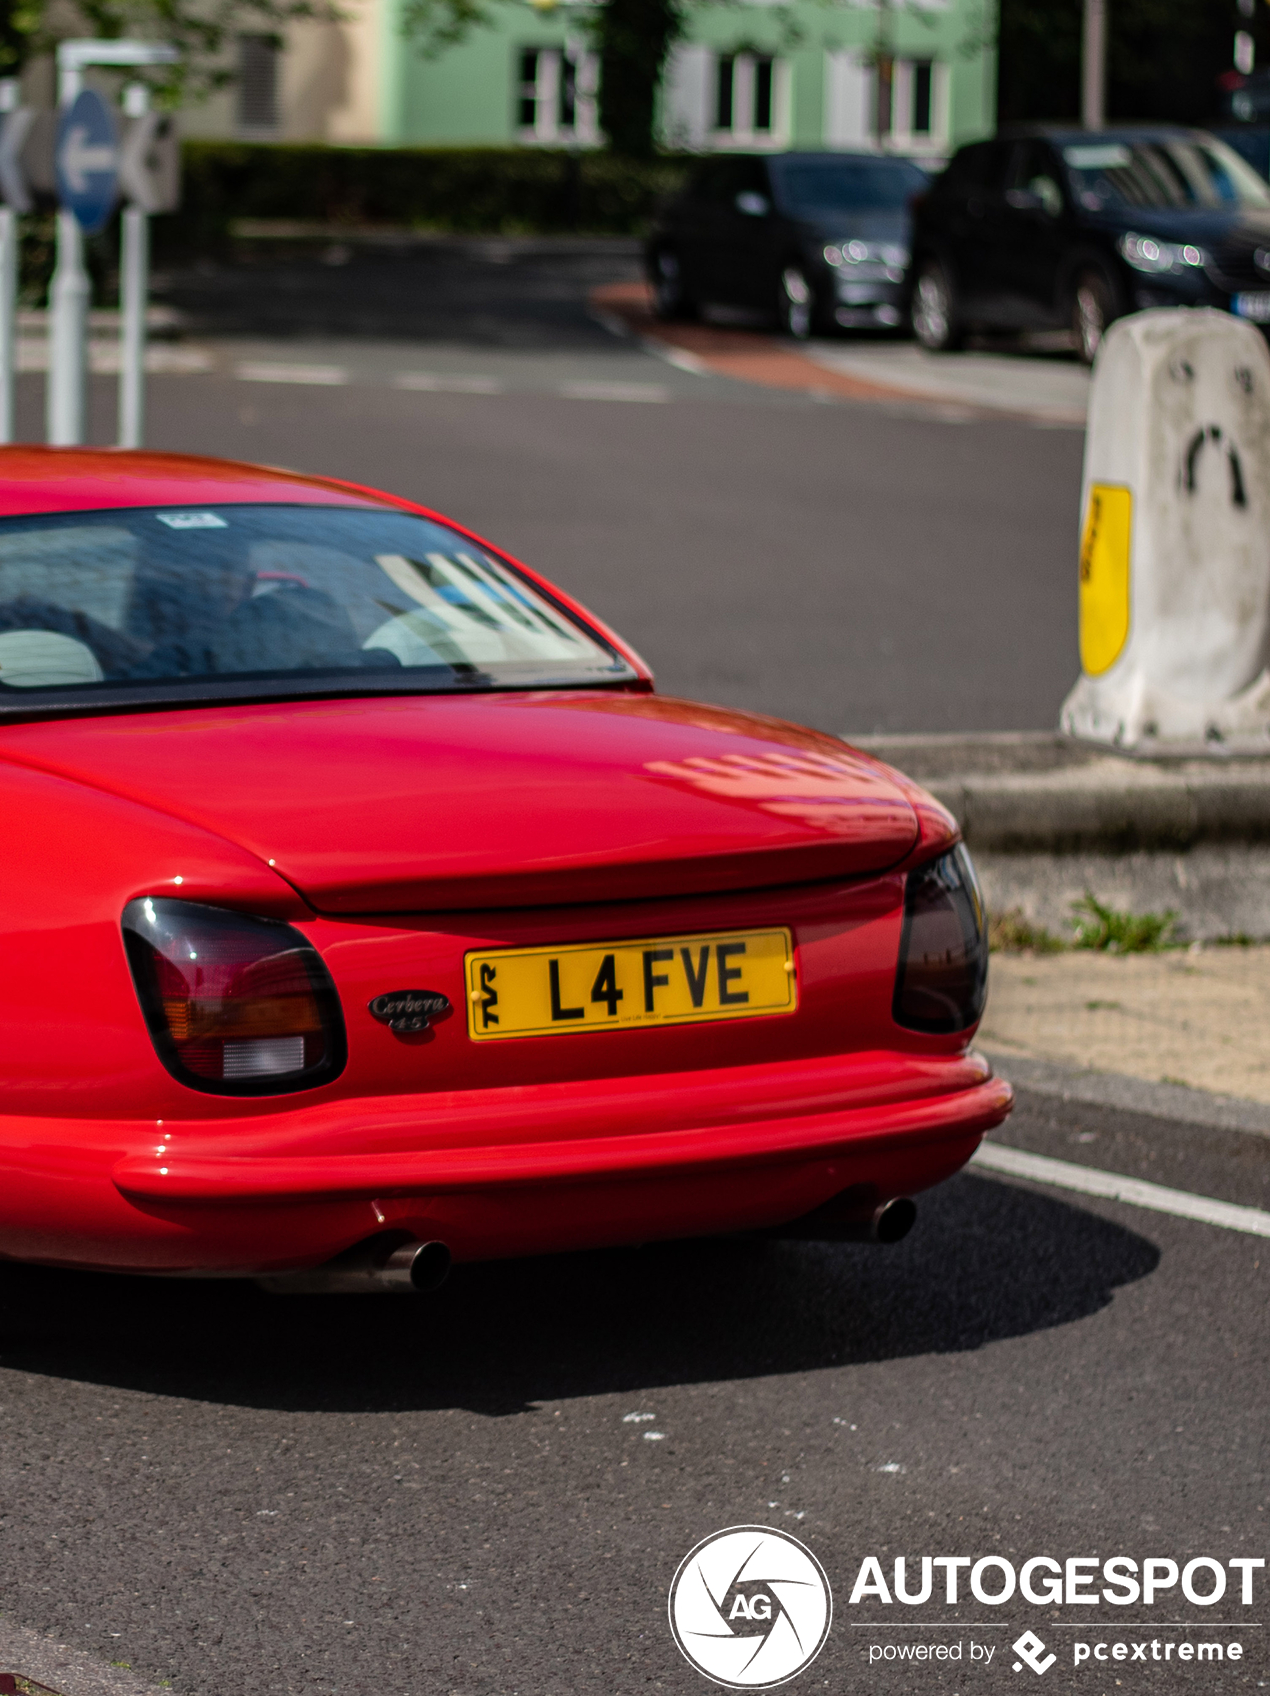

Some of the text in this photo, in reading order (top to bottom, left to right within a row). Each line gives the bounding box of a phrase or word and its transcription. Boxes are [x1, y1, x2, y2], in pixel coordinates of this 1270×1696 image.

[372, 994, 446, 1015] Cerbera
[479, 962, 500, 1030] TVR
[548, 942, 749, 1021] L4 FVE
